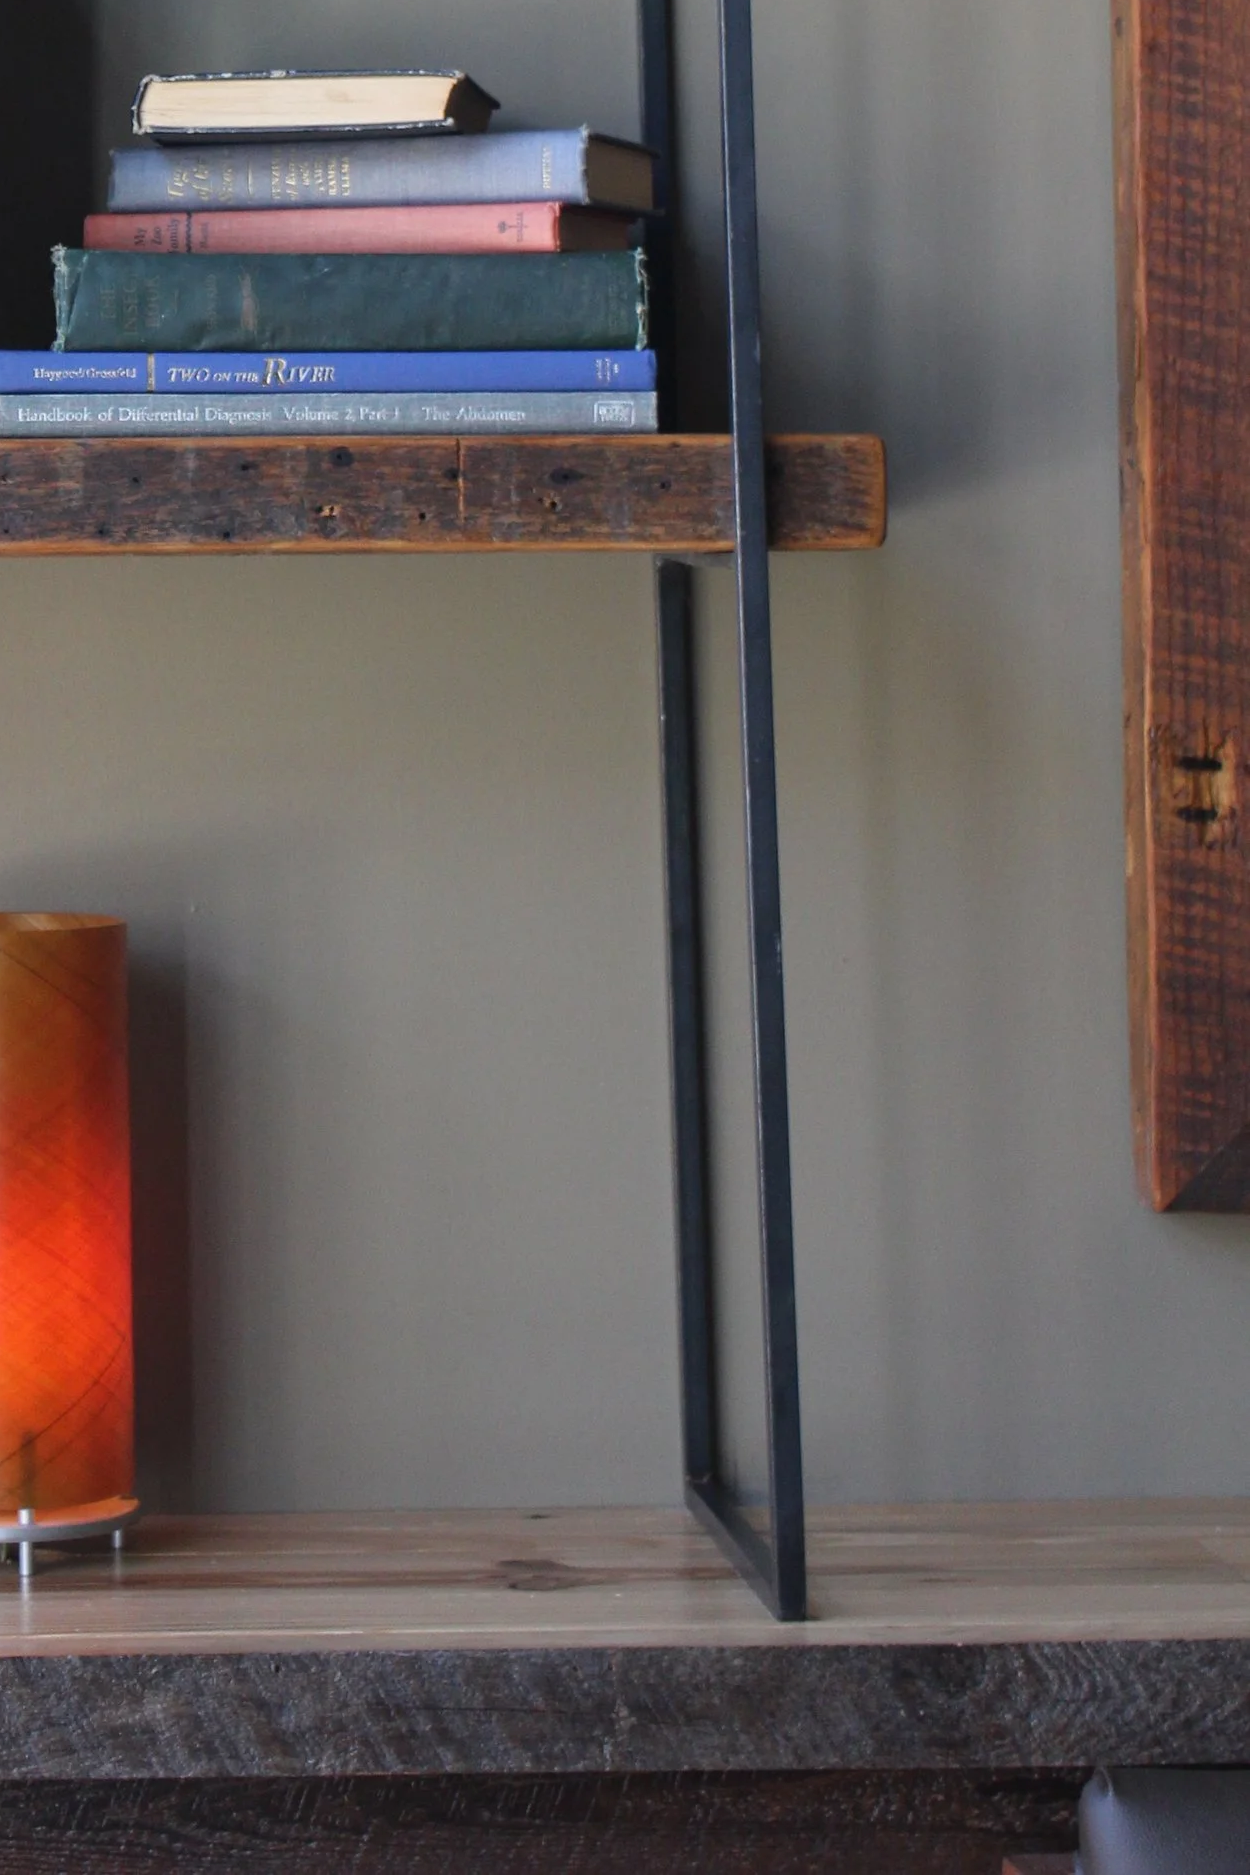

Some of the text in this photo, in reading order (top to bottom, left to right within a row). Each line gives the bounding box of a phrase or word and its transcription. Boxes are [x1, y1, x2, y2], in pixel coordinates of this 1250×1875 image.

[133, 227, 148, 248] My
[150, 226, 163, 247] Zoo
[167, 356, 336, 387] TWO ON THE RIVER
[18, 405, 527, 426] Handbook of Differential Diagnosis Volume Part The Abdomen
